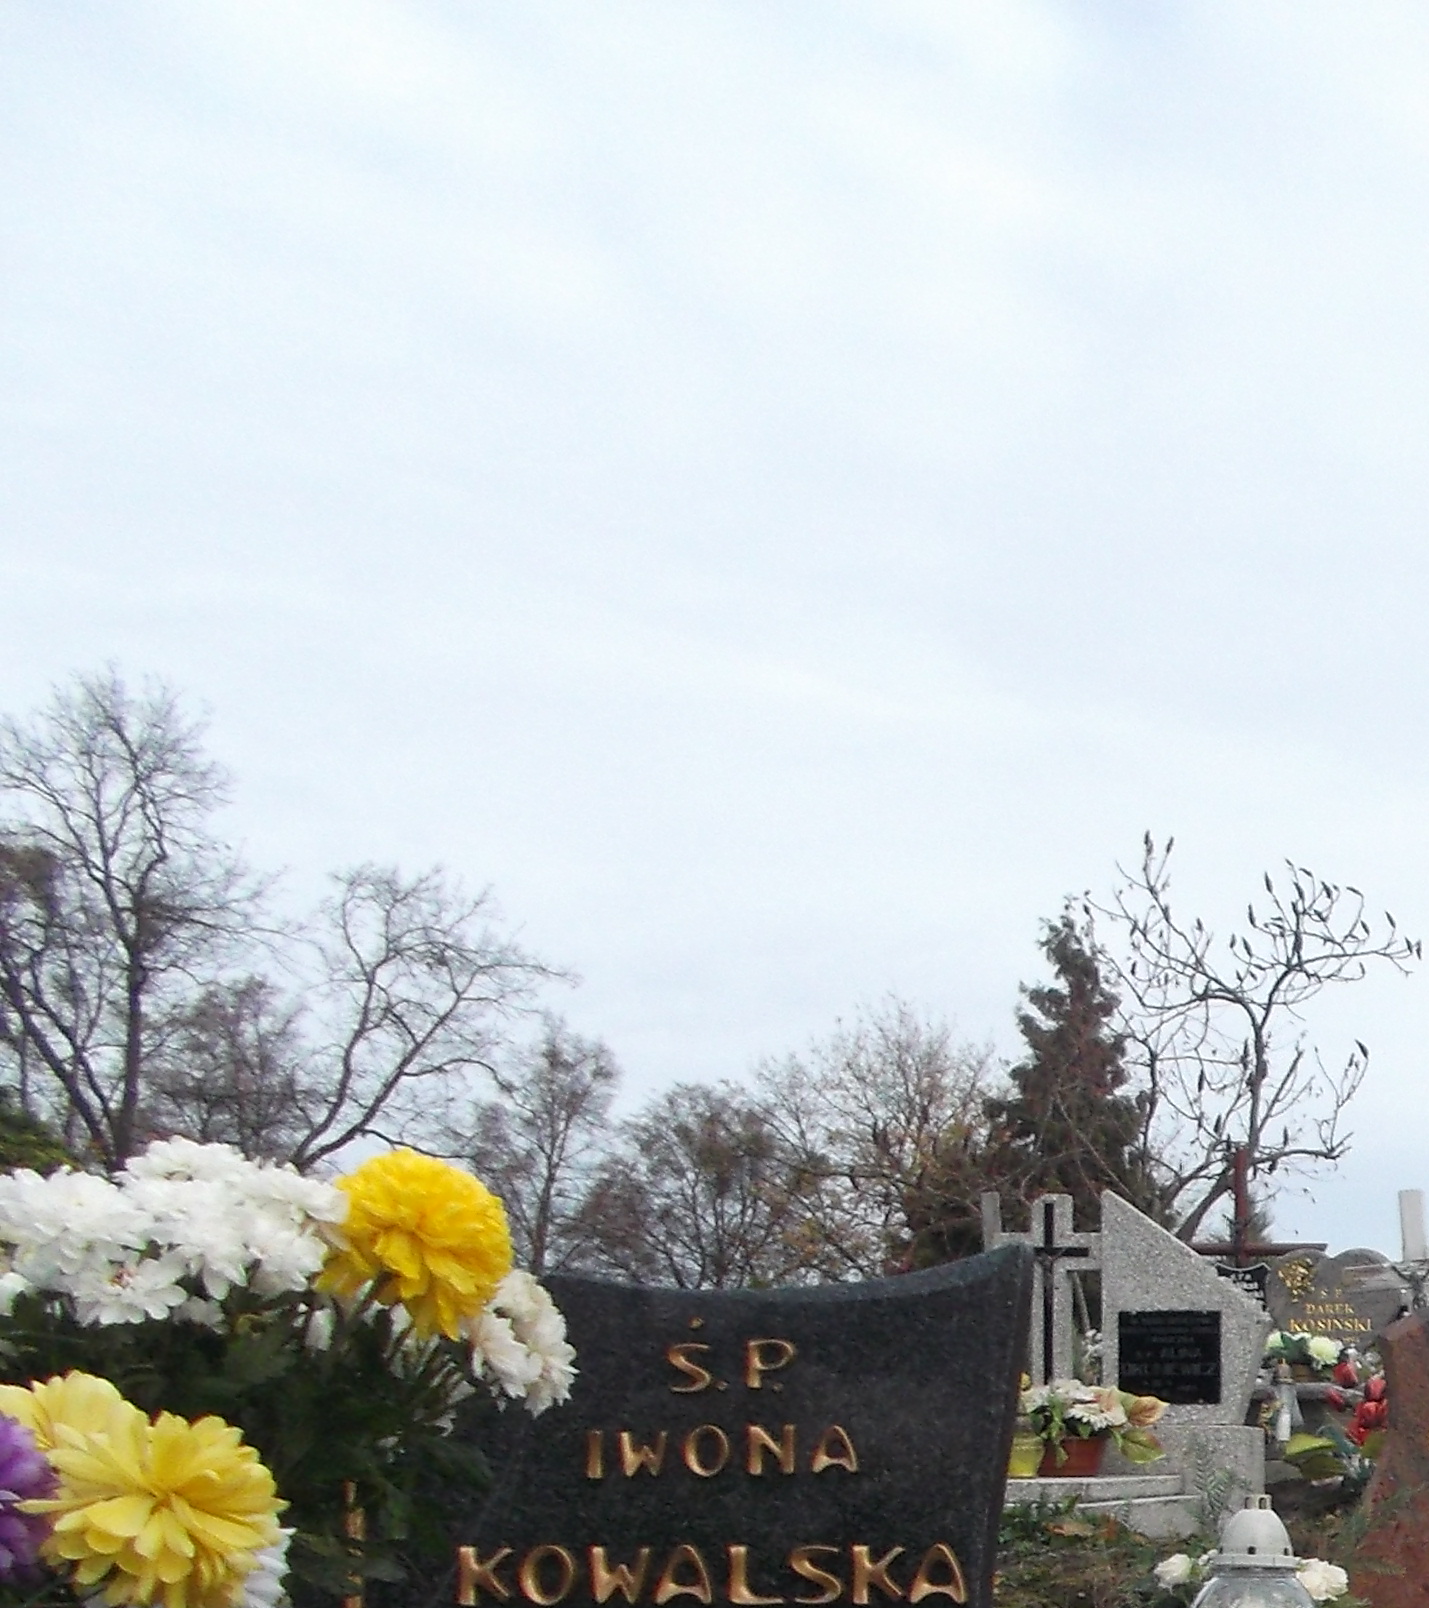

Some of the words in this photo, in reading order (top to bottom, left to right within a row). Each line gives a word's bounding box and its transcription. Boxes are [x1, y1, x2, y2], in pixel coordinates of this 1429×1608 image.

[1304, 1303, 1355, 1315] DAREK
[586, 1423, 860, 1480] IWONA
[457, 1543, 967, 1607] KOWALSKA
